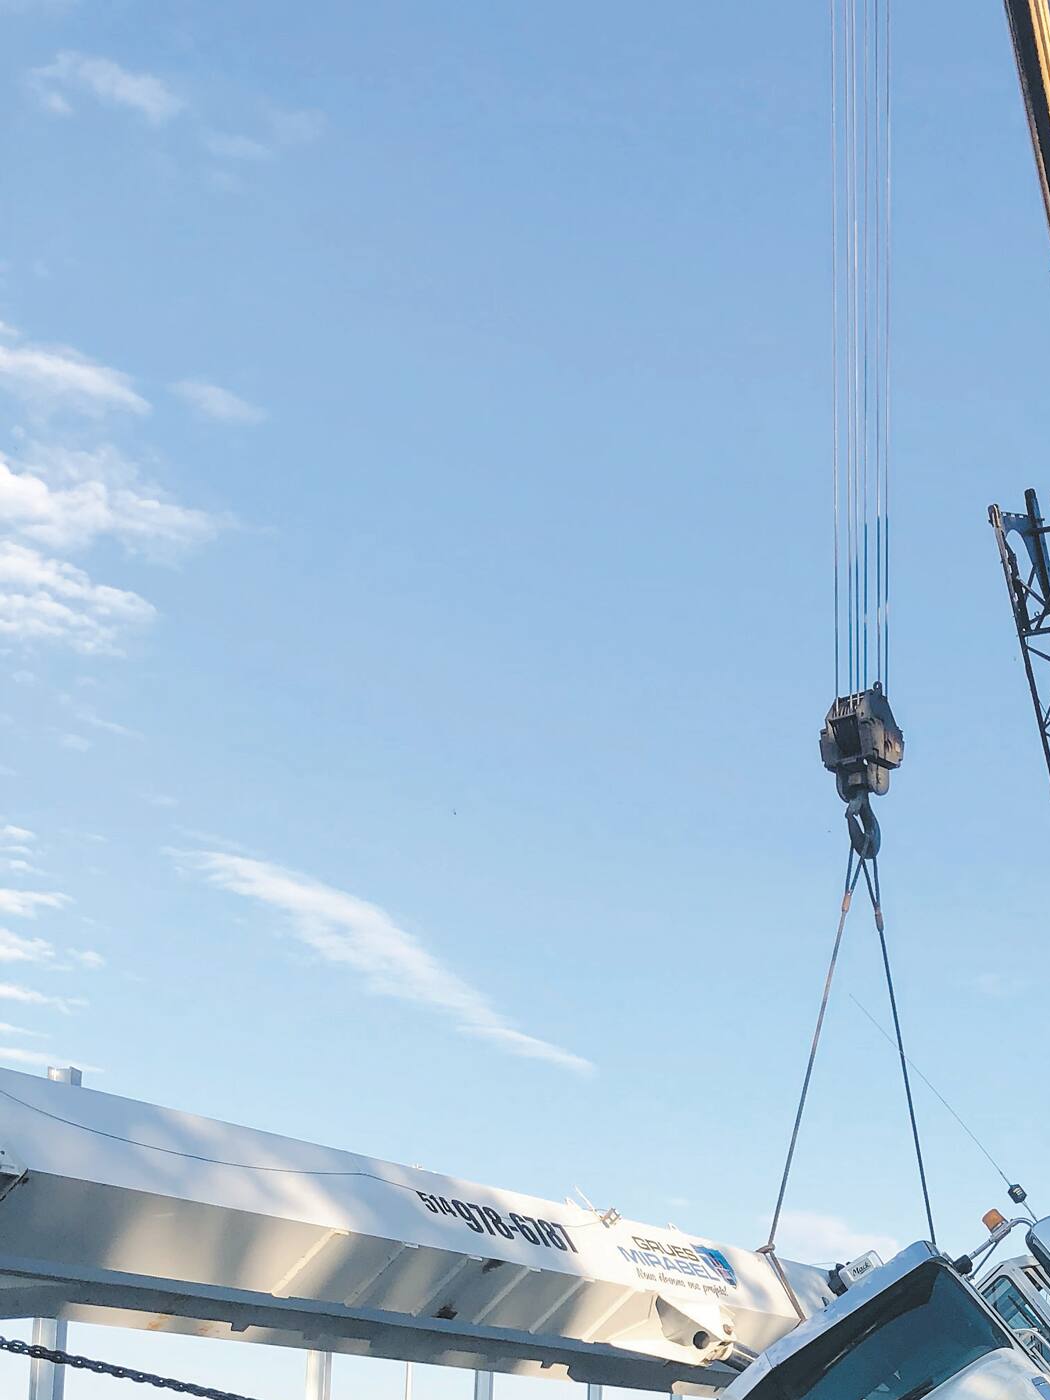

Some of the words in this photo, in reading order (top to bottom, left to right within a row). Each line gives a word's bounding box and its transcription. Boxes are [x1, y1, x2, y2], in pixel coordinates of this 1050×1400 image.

[415, 1190, 458, 1217] 514
[451, 1199, 579, 1254] 978-6787
[617, 1246, 721, 1282] MIRABEL
[631, 1236, 700, 1263] GRUES
[852, 1261, 871, 1277] Mack
